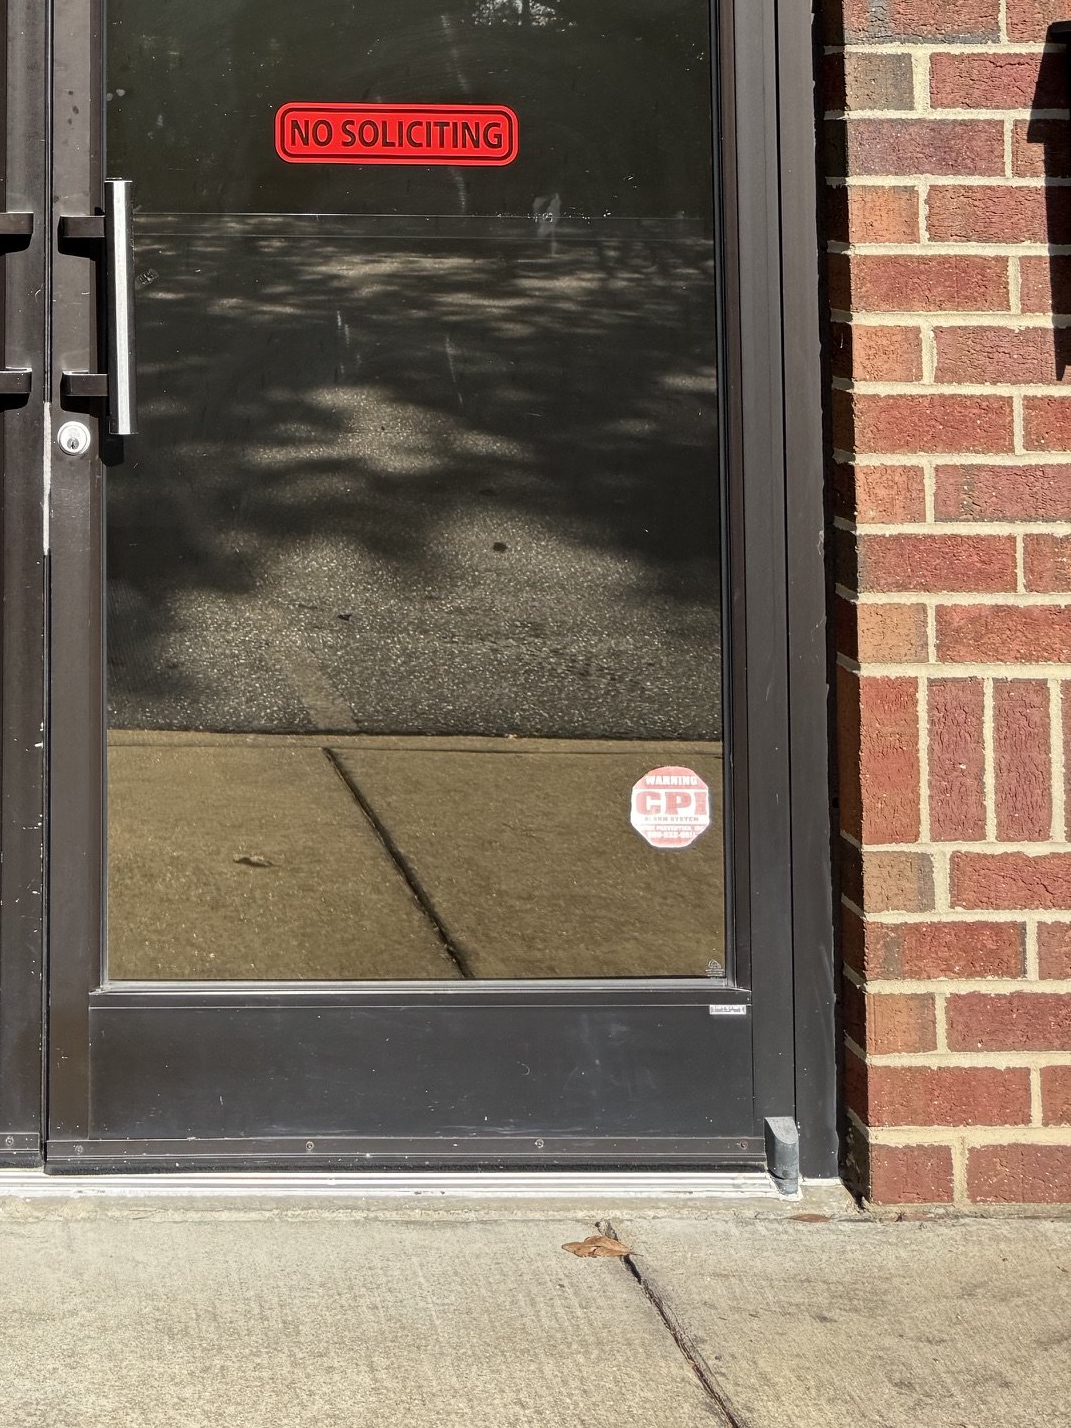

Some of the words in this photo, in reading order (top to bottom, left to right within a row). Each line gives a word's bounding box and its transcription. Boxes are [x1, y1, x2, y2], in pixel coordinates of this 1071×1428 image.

[290, 119, 333, 147] NO
[341, 120, 503, 149] SOLICITING
[645, 775, 698, 786] WARNING
[635, 791, 707, 816] CPI
